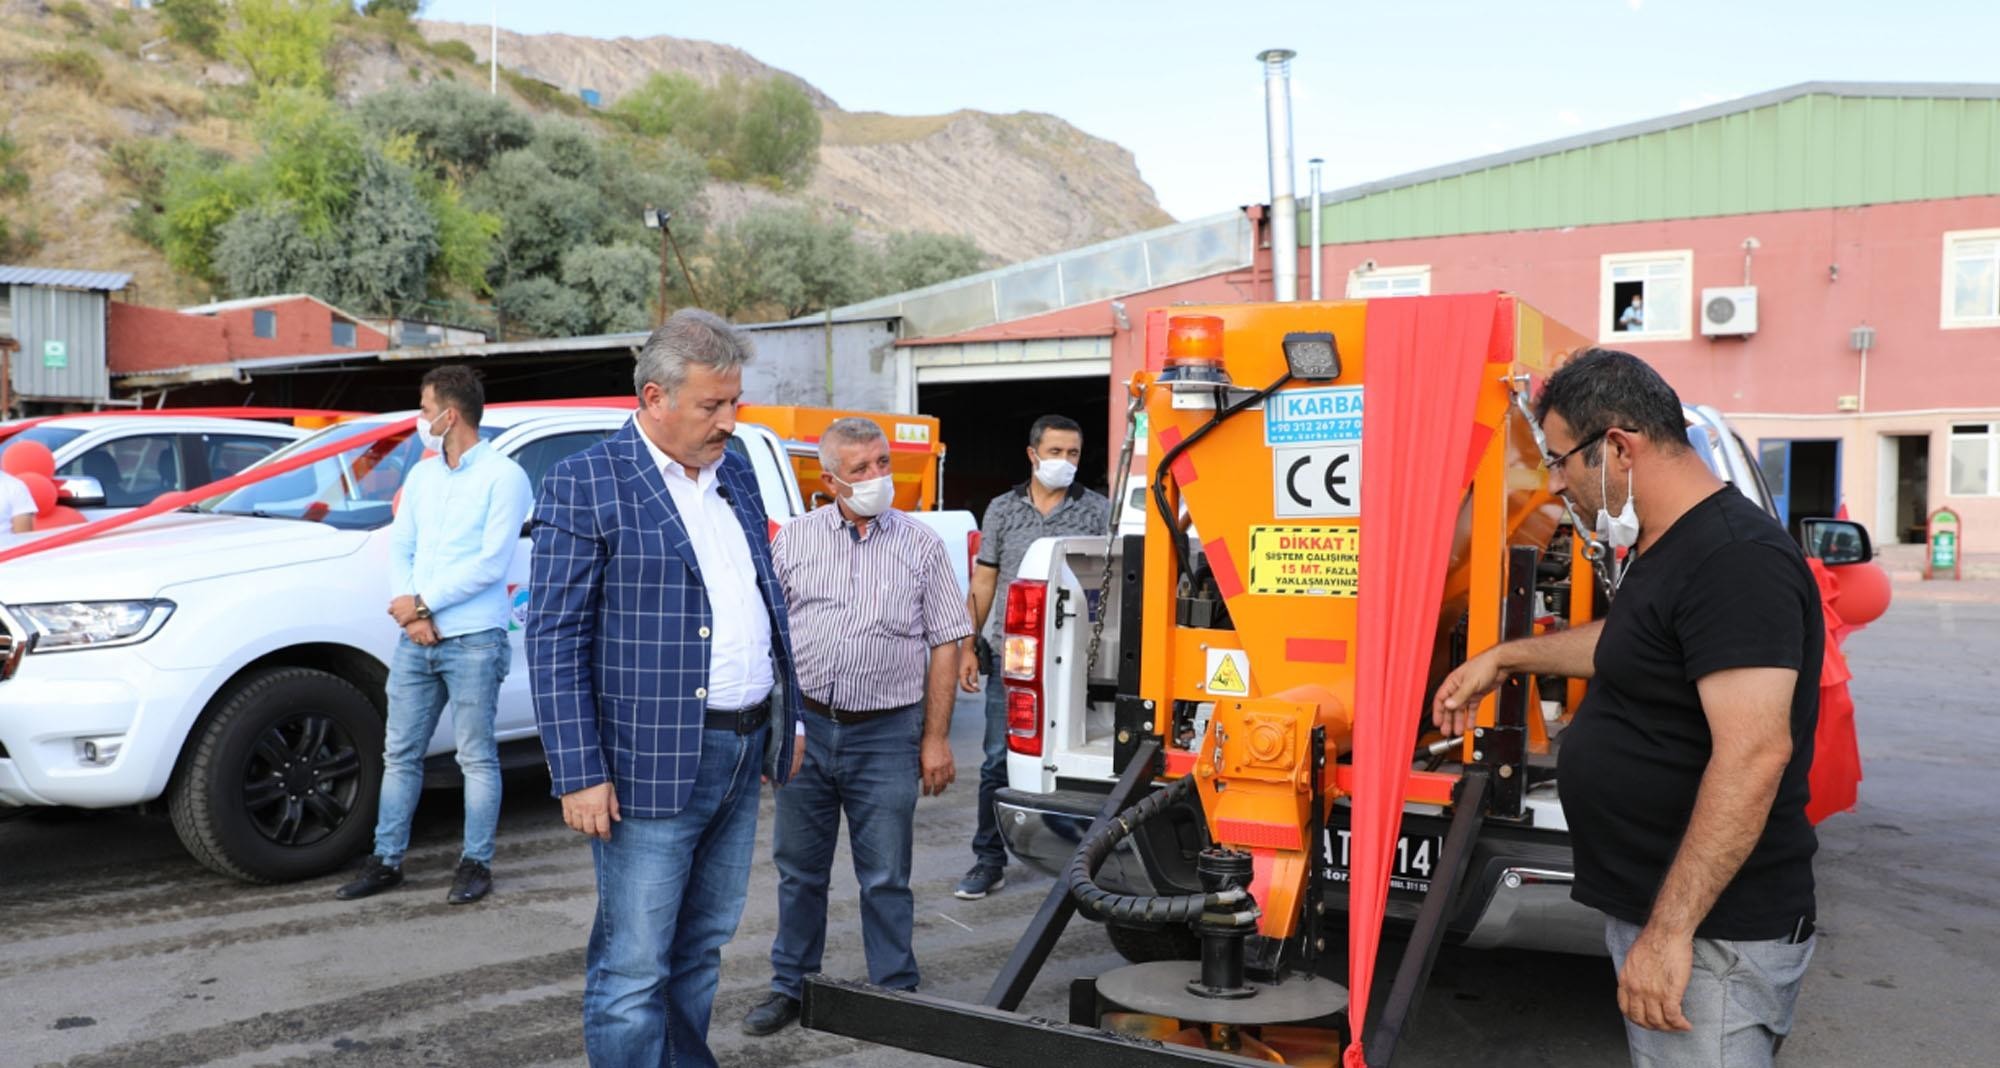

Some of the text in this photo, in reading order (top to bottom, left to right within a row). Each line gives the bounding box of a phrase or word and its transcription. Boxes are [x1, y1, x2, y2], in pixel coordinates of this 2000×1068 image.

[1288, 396, 1363, 416] KARBA
[1293, 421, 1312, 431] 312
[1315, 420, 1335, 430] 267
[1338, 419, 1351, 429] 27
[1286, 454, 1350, 507] CE
[1279, 534, 1344, 551] DİKKAT
[1281, 564, 1357, 576] 15 MT. FAZLA
[1275, 577, 1358, 587] YAKLAŞMAYINIZ
